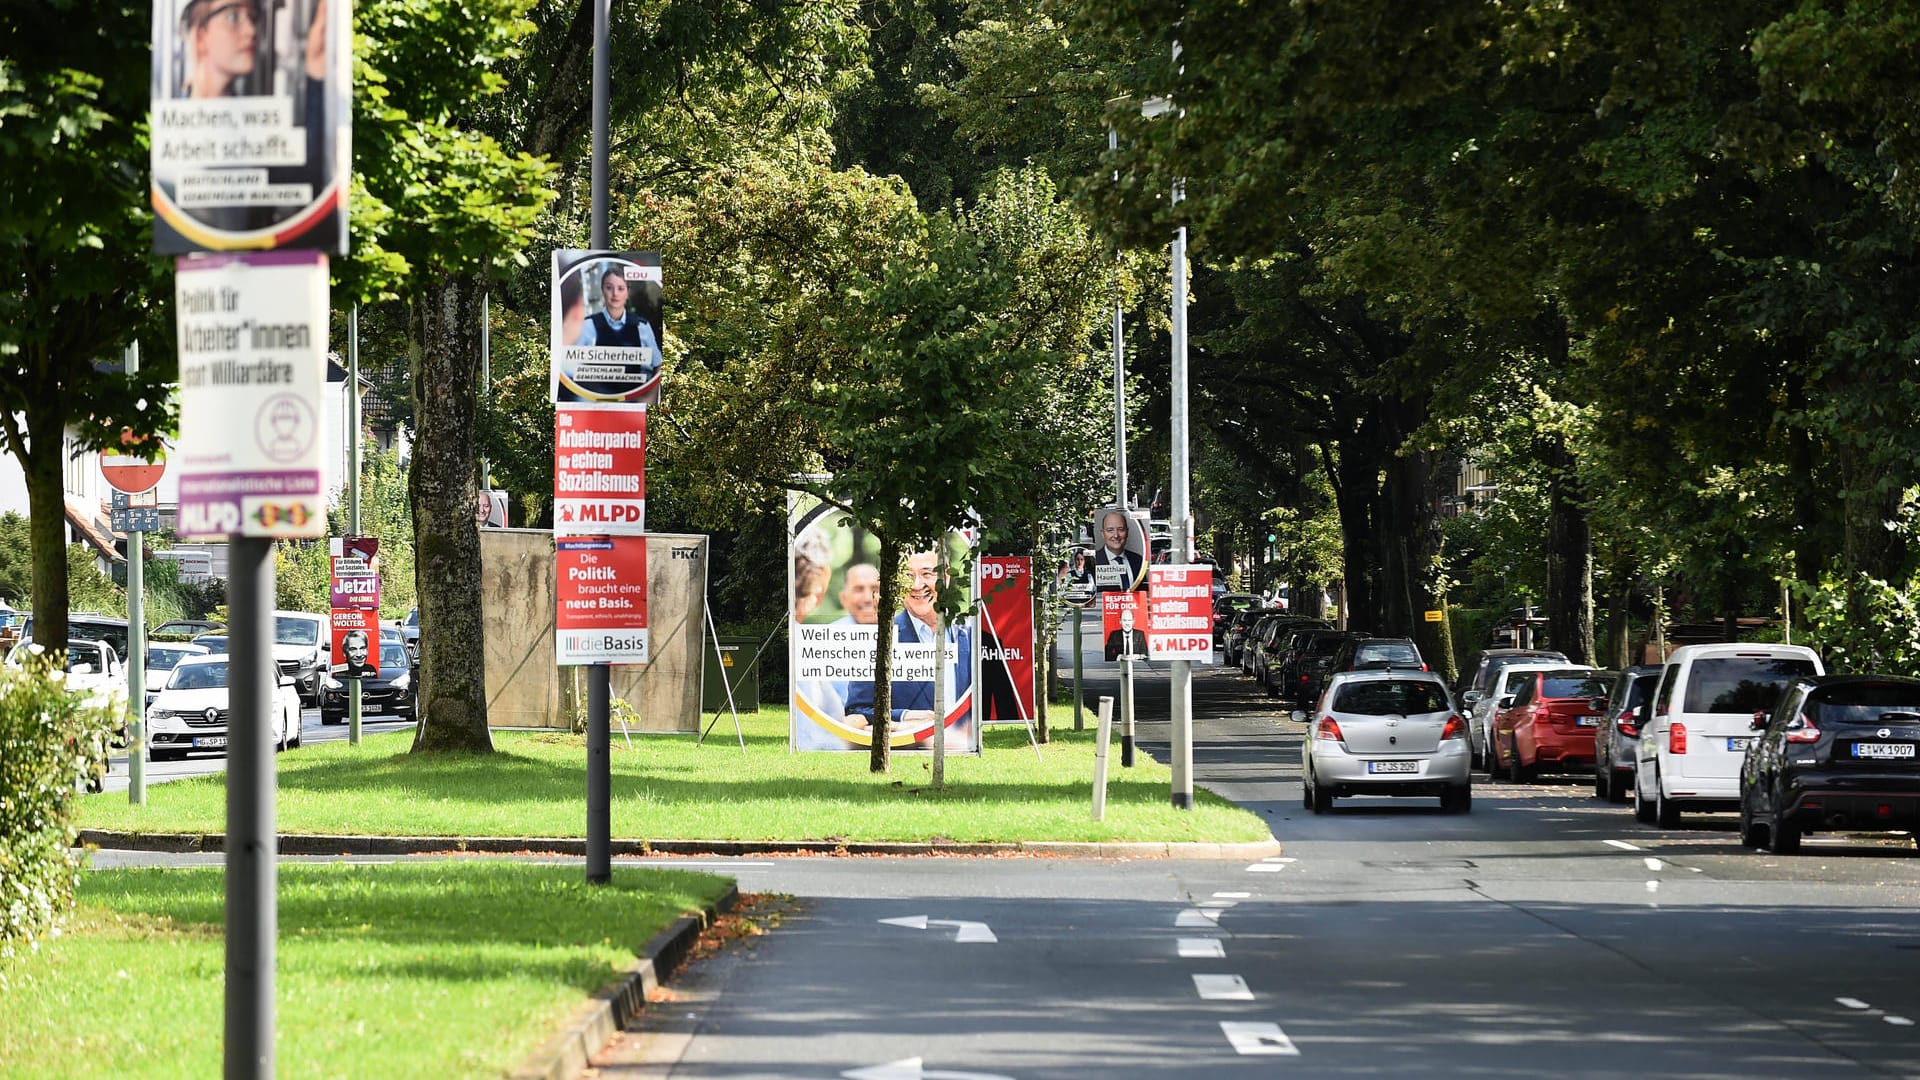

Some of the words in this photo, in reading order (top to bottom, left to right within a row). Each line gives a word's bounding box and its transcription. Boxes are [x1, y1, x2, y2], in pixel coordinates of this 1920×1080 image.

[160, 109, 238, 129] Machen,
[244, 110, 281, 124] was
[161, 140, 216, 160] Arbeit
[566, 350, 585, 361] Mit
[588, 350, 646, 362] Sicherheit.
[559, 413, 573, 427] Die
[559, 429, 641, 450] Arbeiterpartei
[571, 451, 613, 469] echten
[558, 471, 640, 492] Sozialismus
[180, 502, 240, 532] MLPD
[579, 504, 641, 522] MLPD
[580, 553, 598, 564] Die
[569, 566, 616, 581] Politik
[981, 563, 1004, 579] PD
[1097, 565, 1125, 573] Matthias
[335, 578, 376, 594] Jetzt!
[578, 583, 618, 594] braucht
[619, 584, 641, 594] eine
[566, 599, 597, 609] neue
[599, 597, 634, 609] Basis.
[801, 628, 830, 641] Weil
[833, 631, 847, 641] es
[850, 631, 870, 641] um
[1166, 638, 1209, 651] MLPD
[801, 646, 866, 659] Menschen
[869, 647, 901, 663] gt,
[802, 667, 822, 677] um
[906, 664, 934, 681] geht
[1888, 745, 1913, 755] 1907
